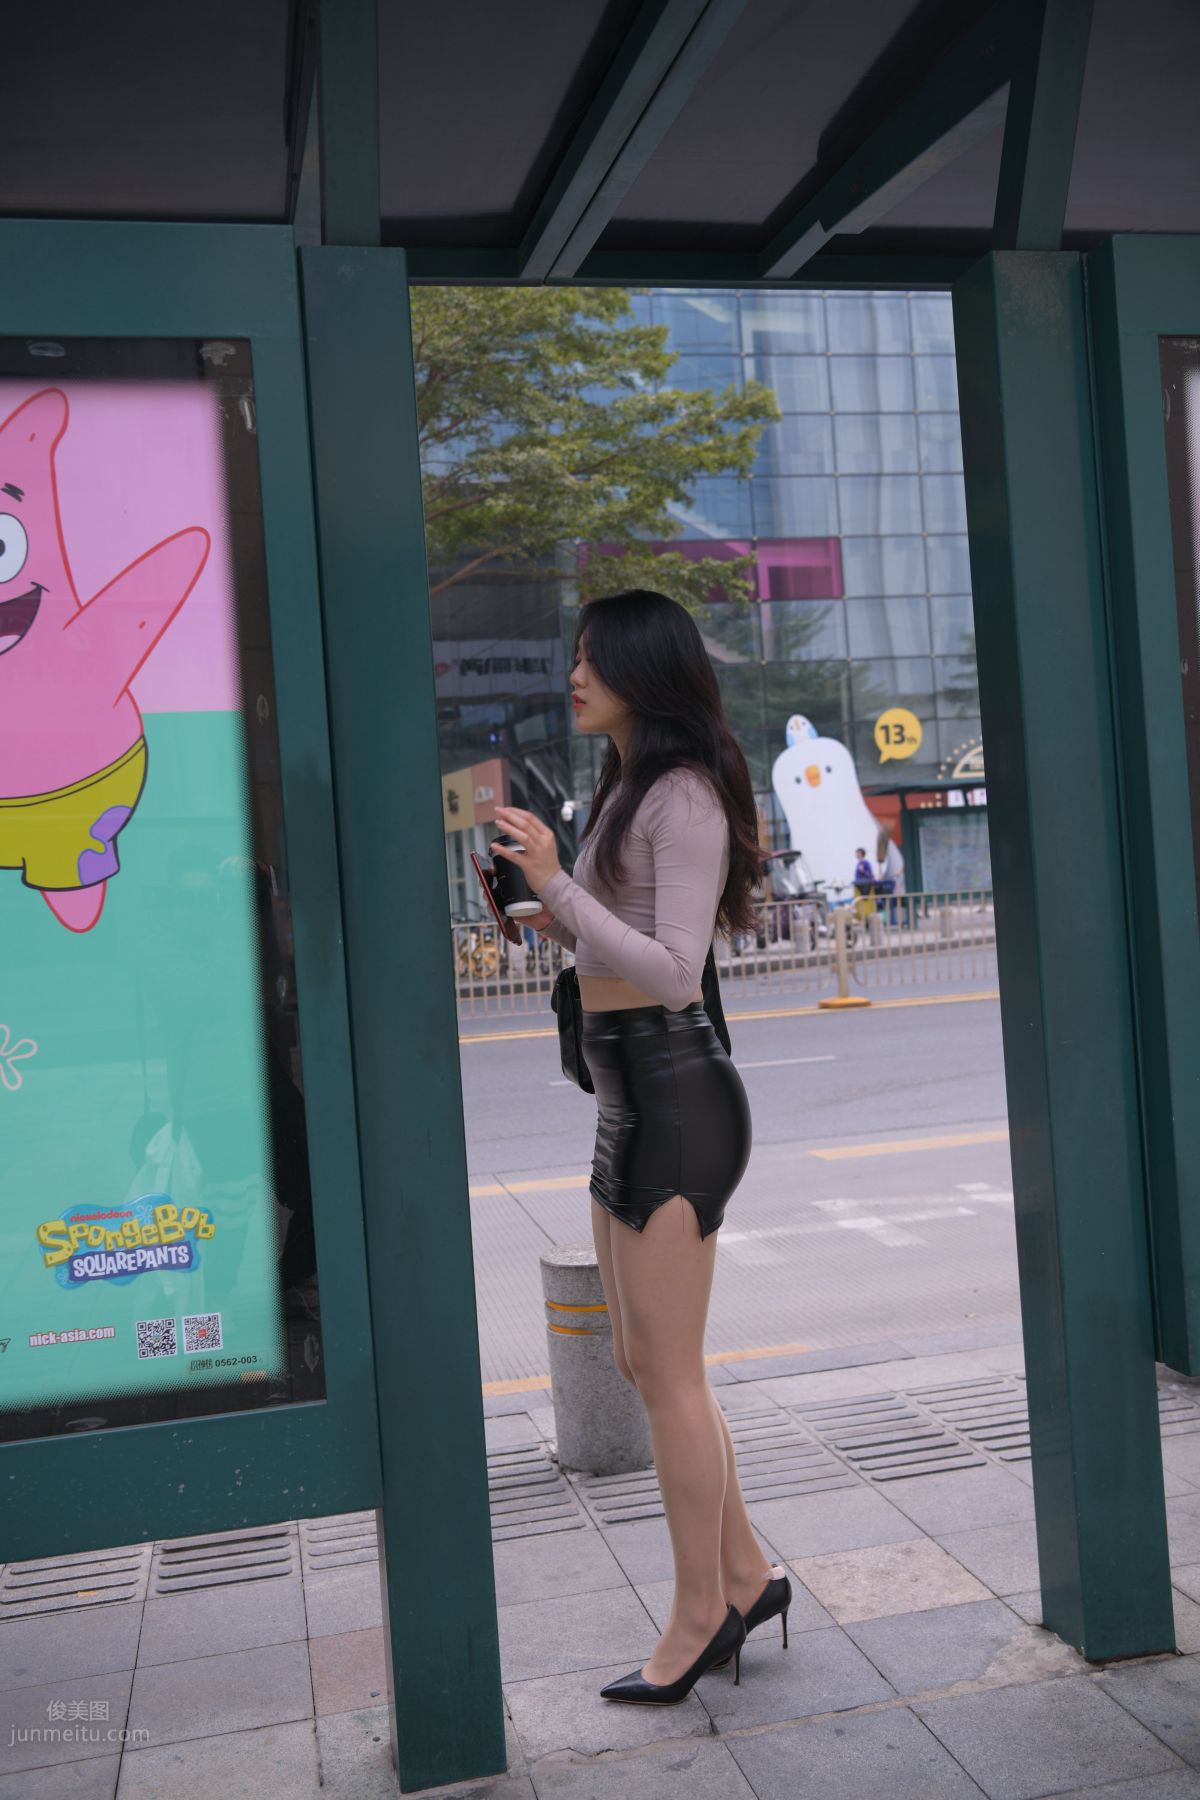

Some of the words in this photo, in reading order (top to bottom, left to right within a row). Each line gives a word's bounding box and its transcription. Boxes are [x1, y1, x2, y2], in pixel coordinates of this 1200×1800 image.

[73, 1245, 190, 1277] SQUAREPANTS
[29, 1326, 115, 1347] nick-asia.com
[214, 1355, 258, 1368] 0562-003
